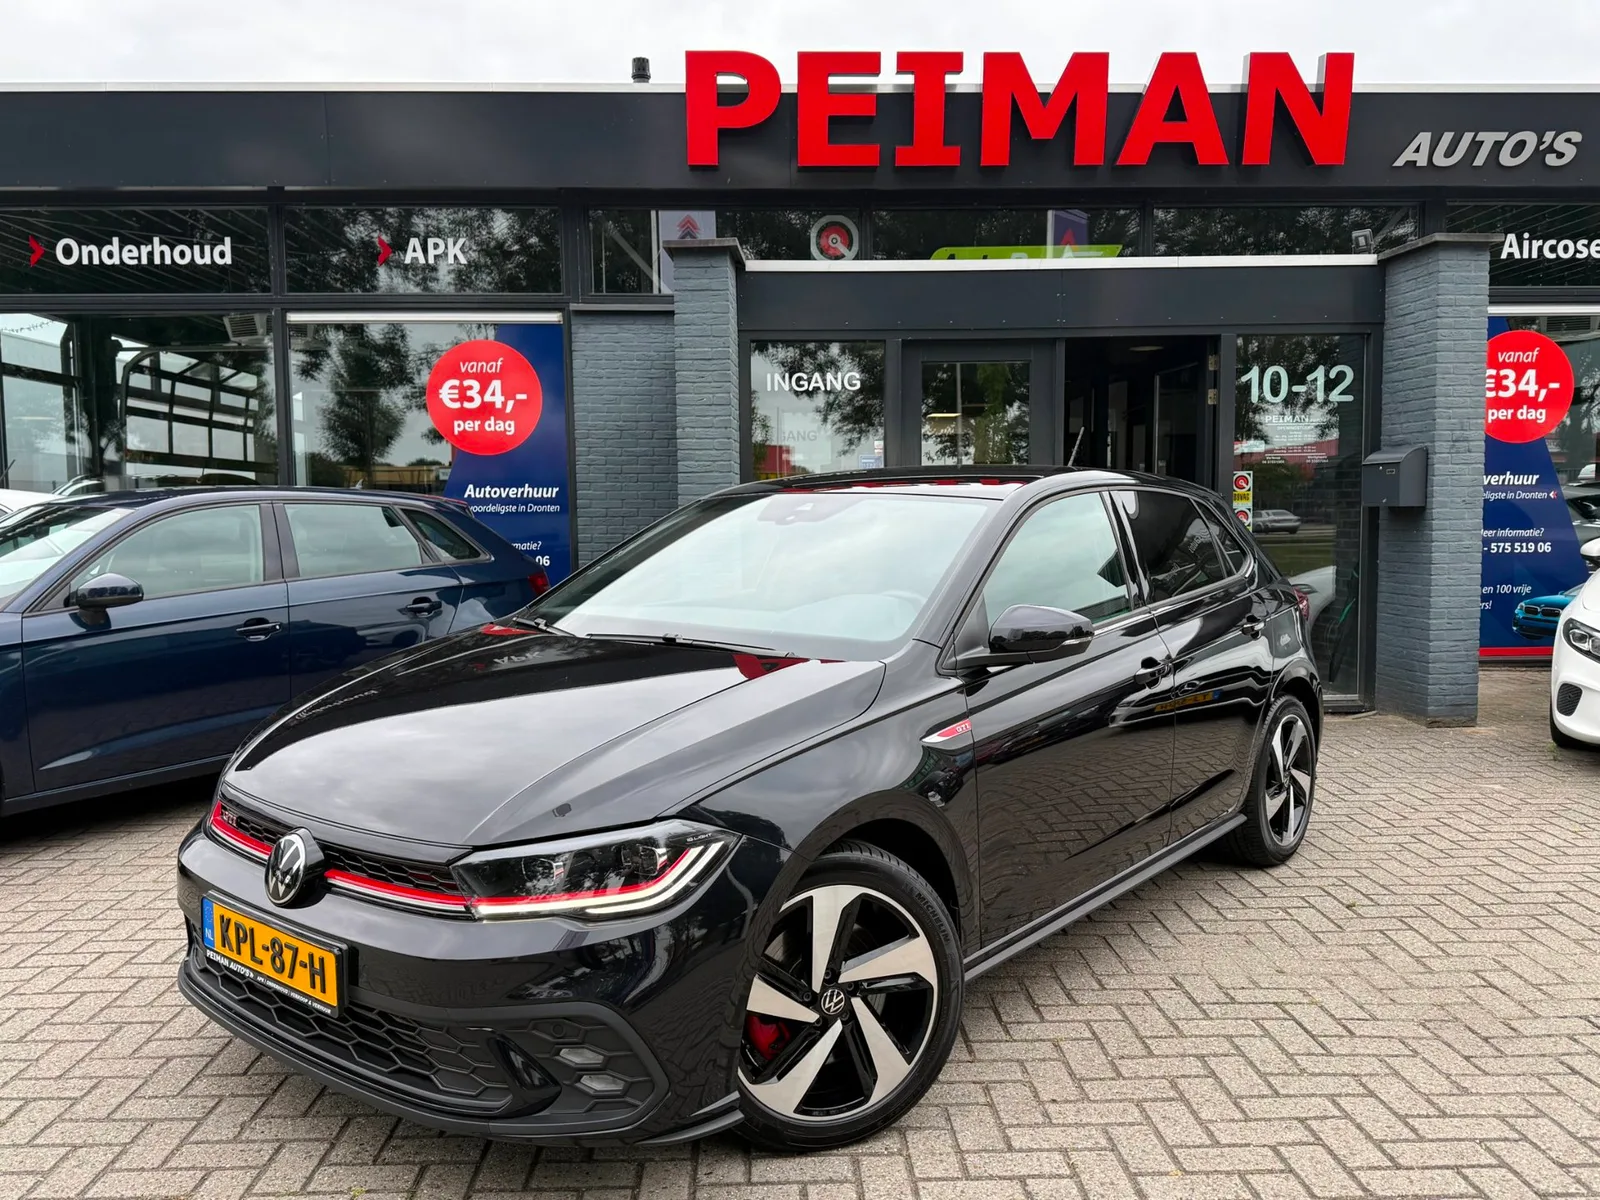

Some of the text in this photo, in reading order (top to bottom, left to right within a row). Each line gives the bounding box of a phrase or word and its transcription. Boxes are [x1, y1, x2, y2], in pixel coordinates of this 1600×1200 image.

[685, 51, 1355, 167] PEIMAN
[1392, 131, 1582, 167] AUTO'S
[55, 237, 232, 265] Onderhoud
[404, 237, 467, 264] APK
[1500, 232, 1600, 259] Aircose
[1498, 347, 1540, 362] vanaf
[459, 357, 503, 373] vanaf
[766, 372, 861, 391] INGANG
[1240, 365, 1354, 403] 10-12
[1485, 369, 1560, 402] €34,-
[439, 379, 527, 413] €34,-
[1265, 415, 1309, 423] PEIMAN
[1488, 405, 1546, 423] per dag
[454, 416, 515, 435] per dag
[1483, 471, 1539, 485] verhuur
[464, 484, 559, 498] Autoverhuur
[1507, 490, 1515, 499] in
[1516, 490, 1548, 499] Dronten
[518, 504, 526, 512] in
[527, 504, 560, 512] Dronten
[1481, 528, 1545, 537] eer informatie?
[511, 541, 542, 550] matie?
[1490, 542, 1512, 553] 575
[1514, 542, 1535, 553] 519
[1537, 542, 1552, 553] 06
[1482, 584, 1532, 596] en 100 vrije
[914, 892, 951, 944] MICHELIN
[205, 928, 214, 941] NL
[206, 949, 230, 967] PEIMAN
[219, 914, 326, 995] KPL-87-H
